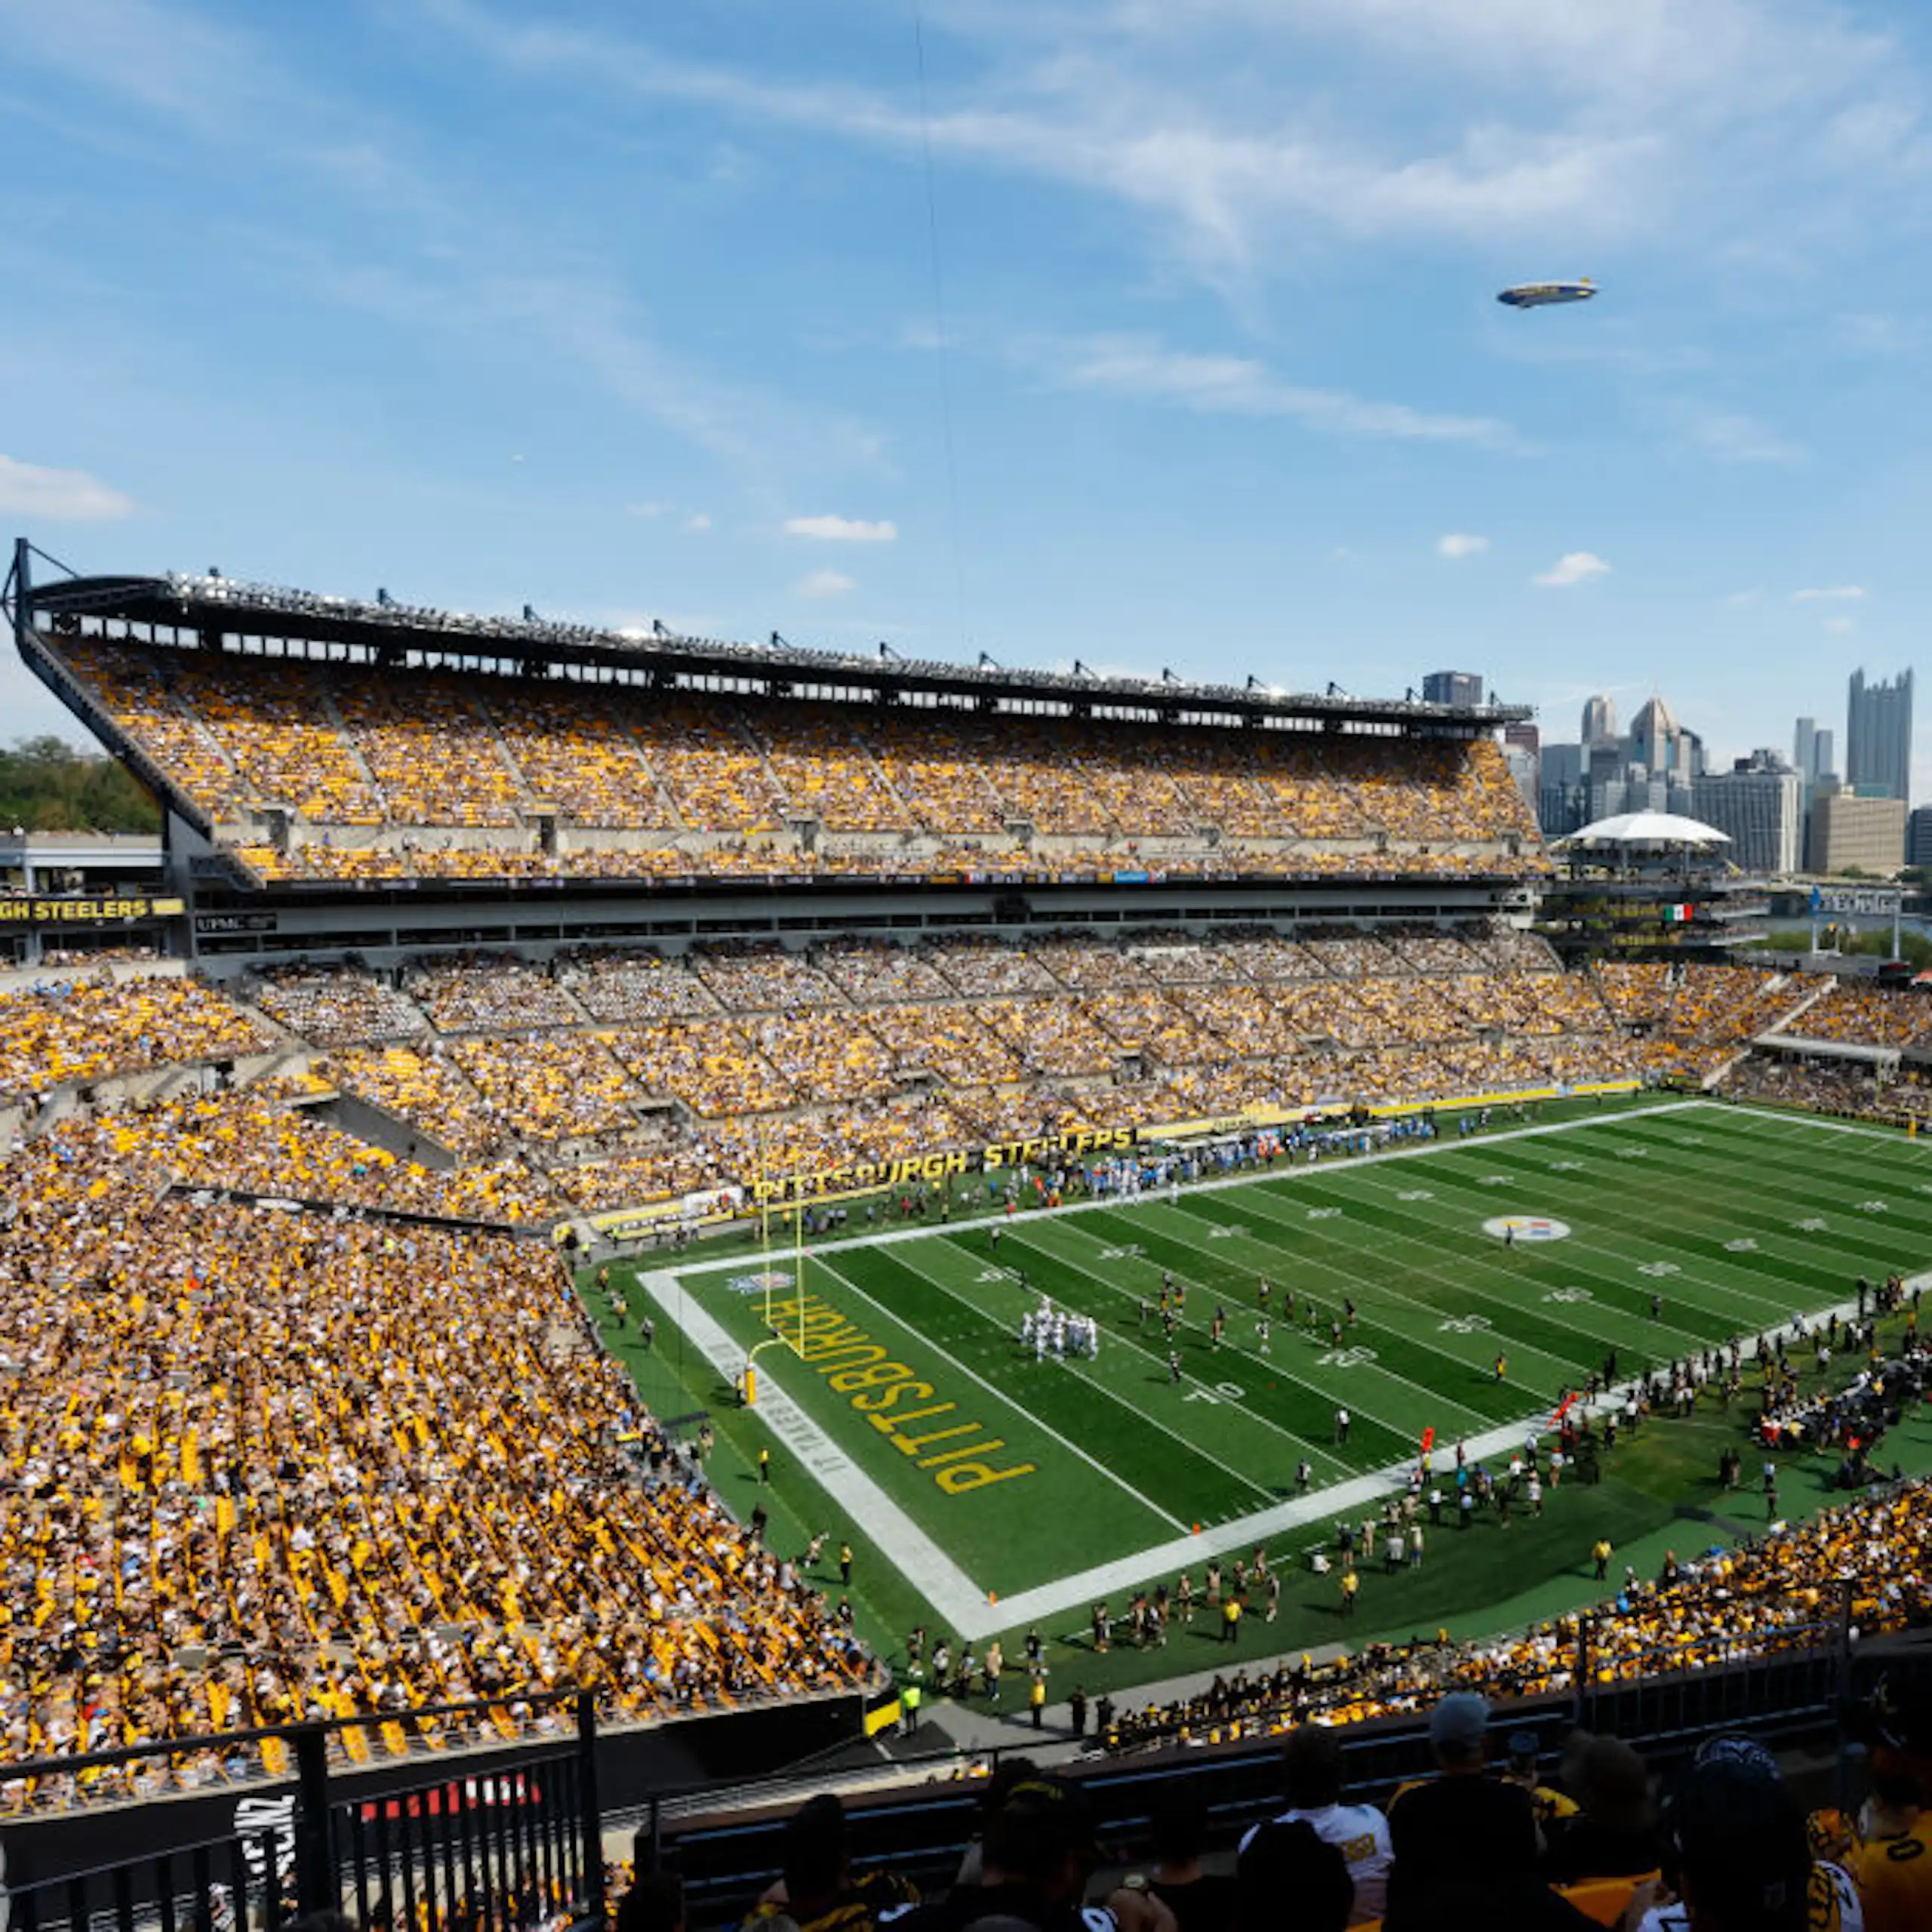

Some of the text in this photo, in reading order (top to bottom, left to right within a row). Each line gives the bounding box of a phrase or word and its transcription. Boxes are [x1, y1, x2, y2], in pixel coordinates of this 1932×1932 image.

[34, 899, 149, 920] STEELERS
[751, 1294, 1037, 1495] PITTSBURGH
[1182, 1381, 1247, 1405] 10
